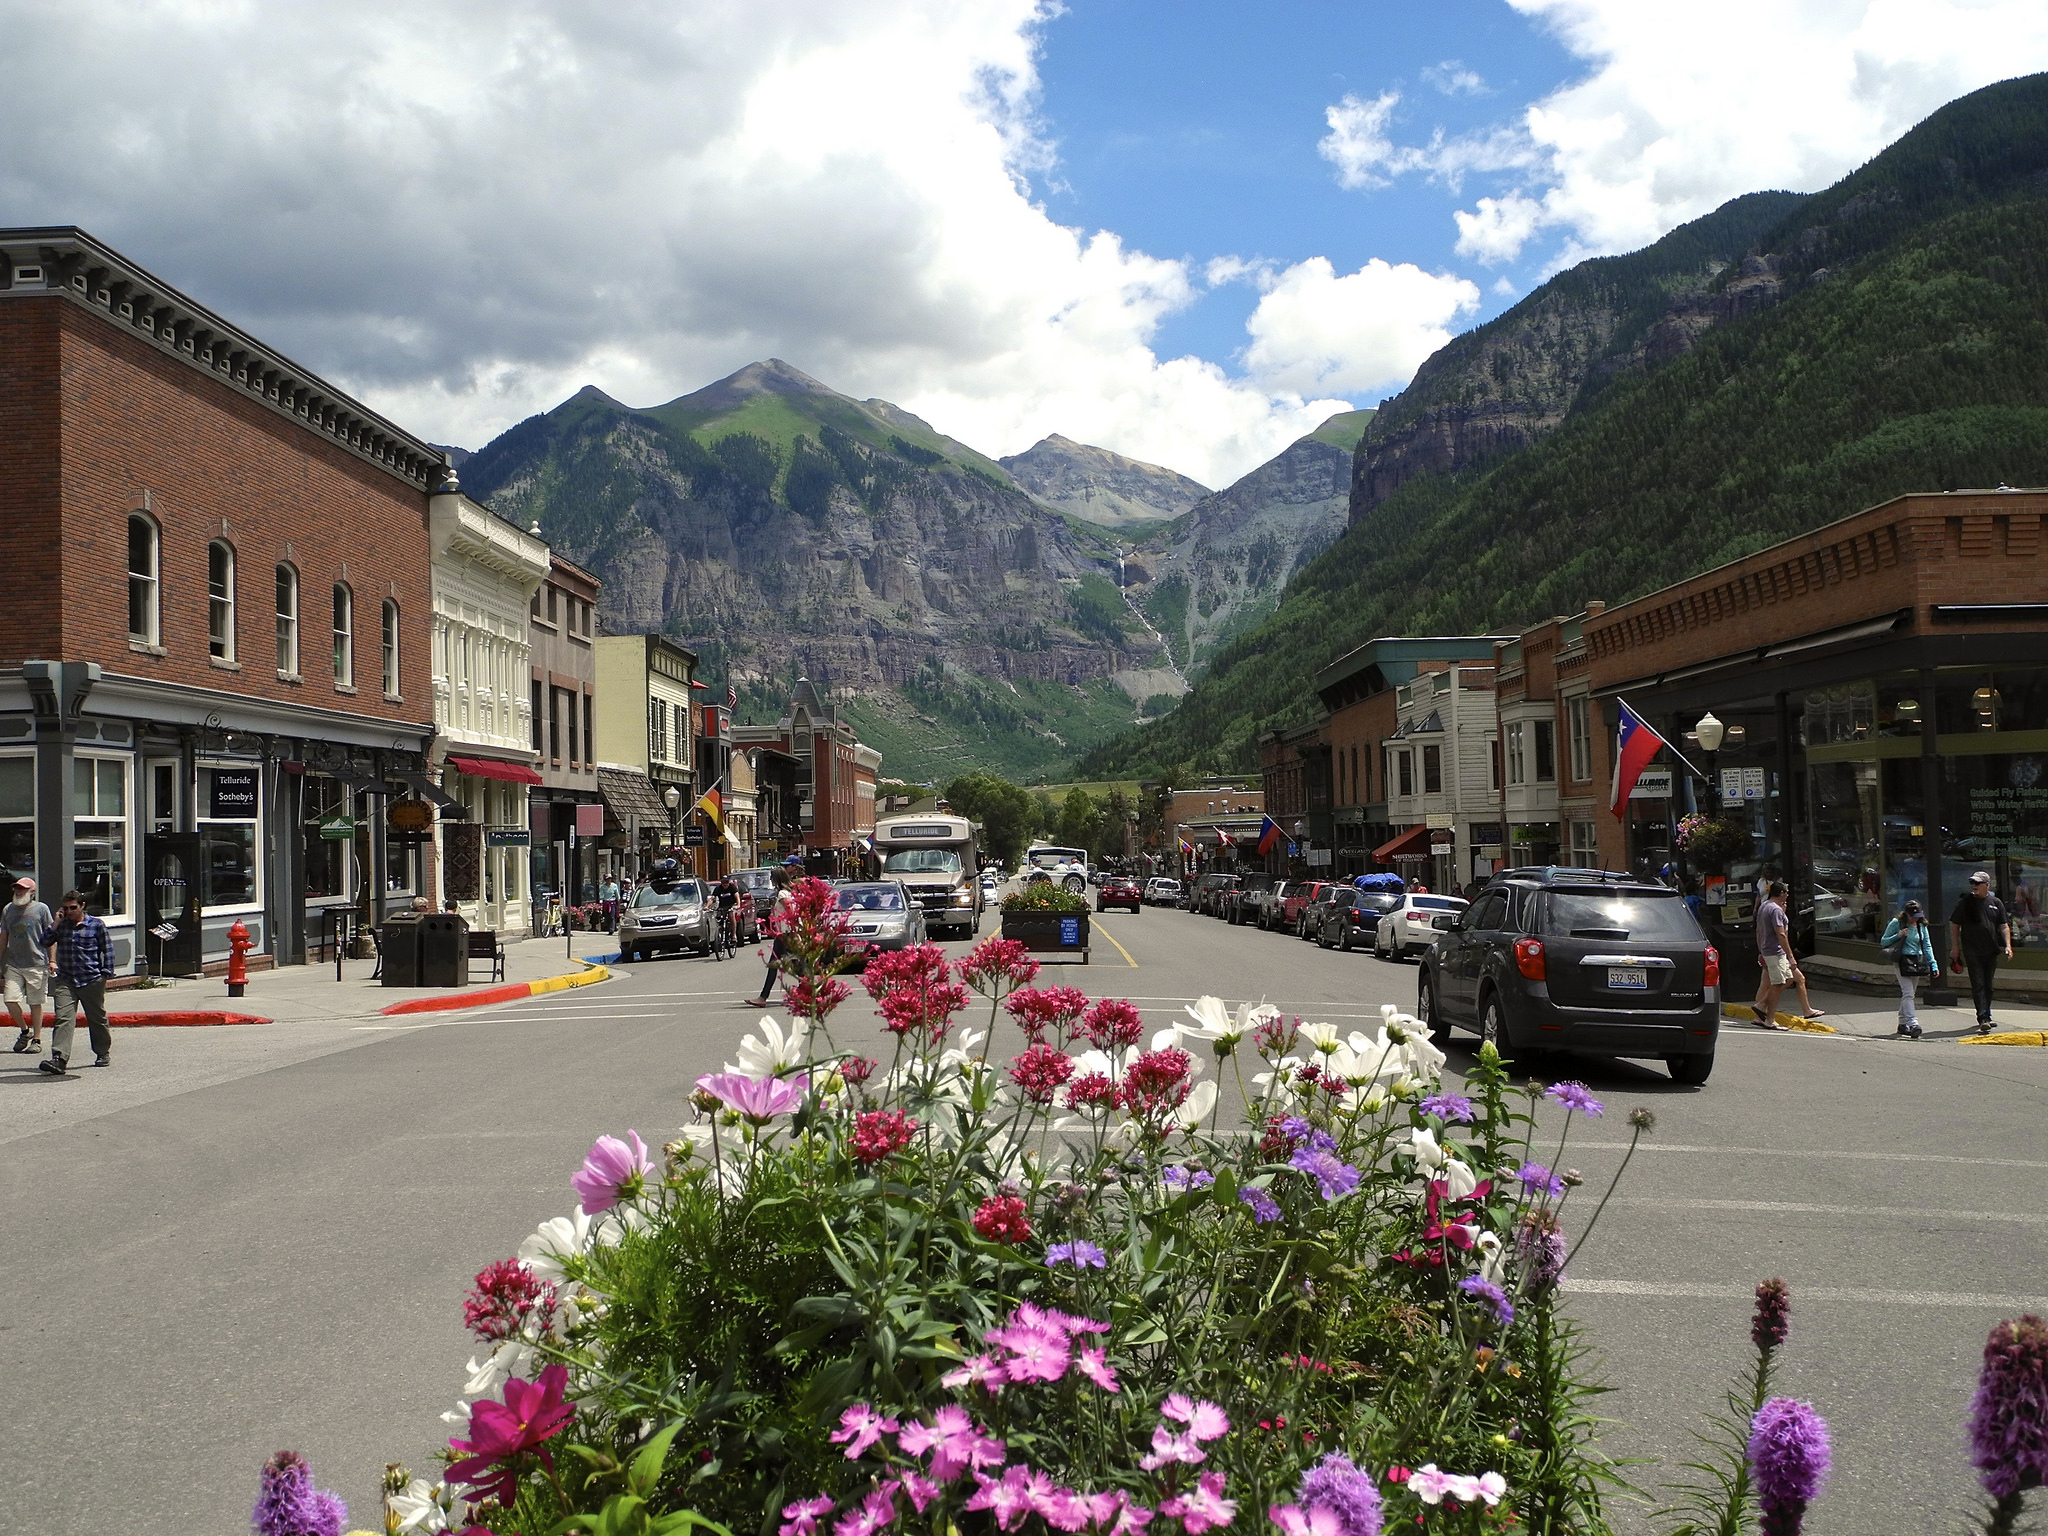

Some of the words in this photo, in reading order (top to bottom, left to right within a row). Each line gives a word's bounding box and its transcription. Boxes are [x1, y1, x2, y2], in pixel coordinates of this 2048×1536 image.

[219, 776, 251, 784] Telluride
[218, 791, 254, 802] Sotheby's
[1970, 788, 2000, 797] Guided
[2001, 788, 2014, 798] Fly
[2016, 787, 2048, 798] Fishing
[1970, 800, 1995, 809] White
[1997, 800, 2023, 809] Water
[1971, 812, 1984, 822] Fly
[1985, 812, 2007, 822] Shop
[1971, 824, 1987, 833] 4x4
[1989, 824, 2014, 833] Tours
[2019, 836, 2047, 846] Riding
[153, 878, 173, 886] OPEN
[1610, 973, 1623, 984] S32
[1628, 973, 1645, 984] 9514
